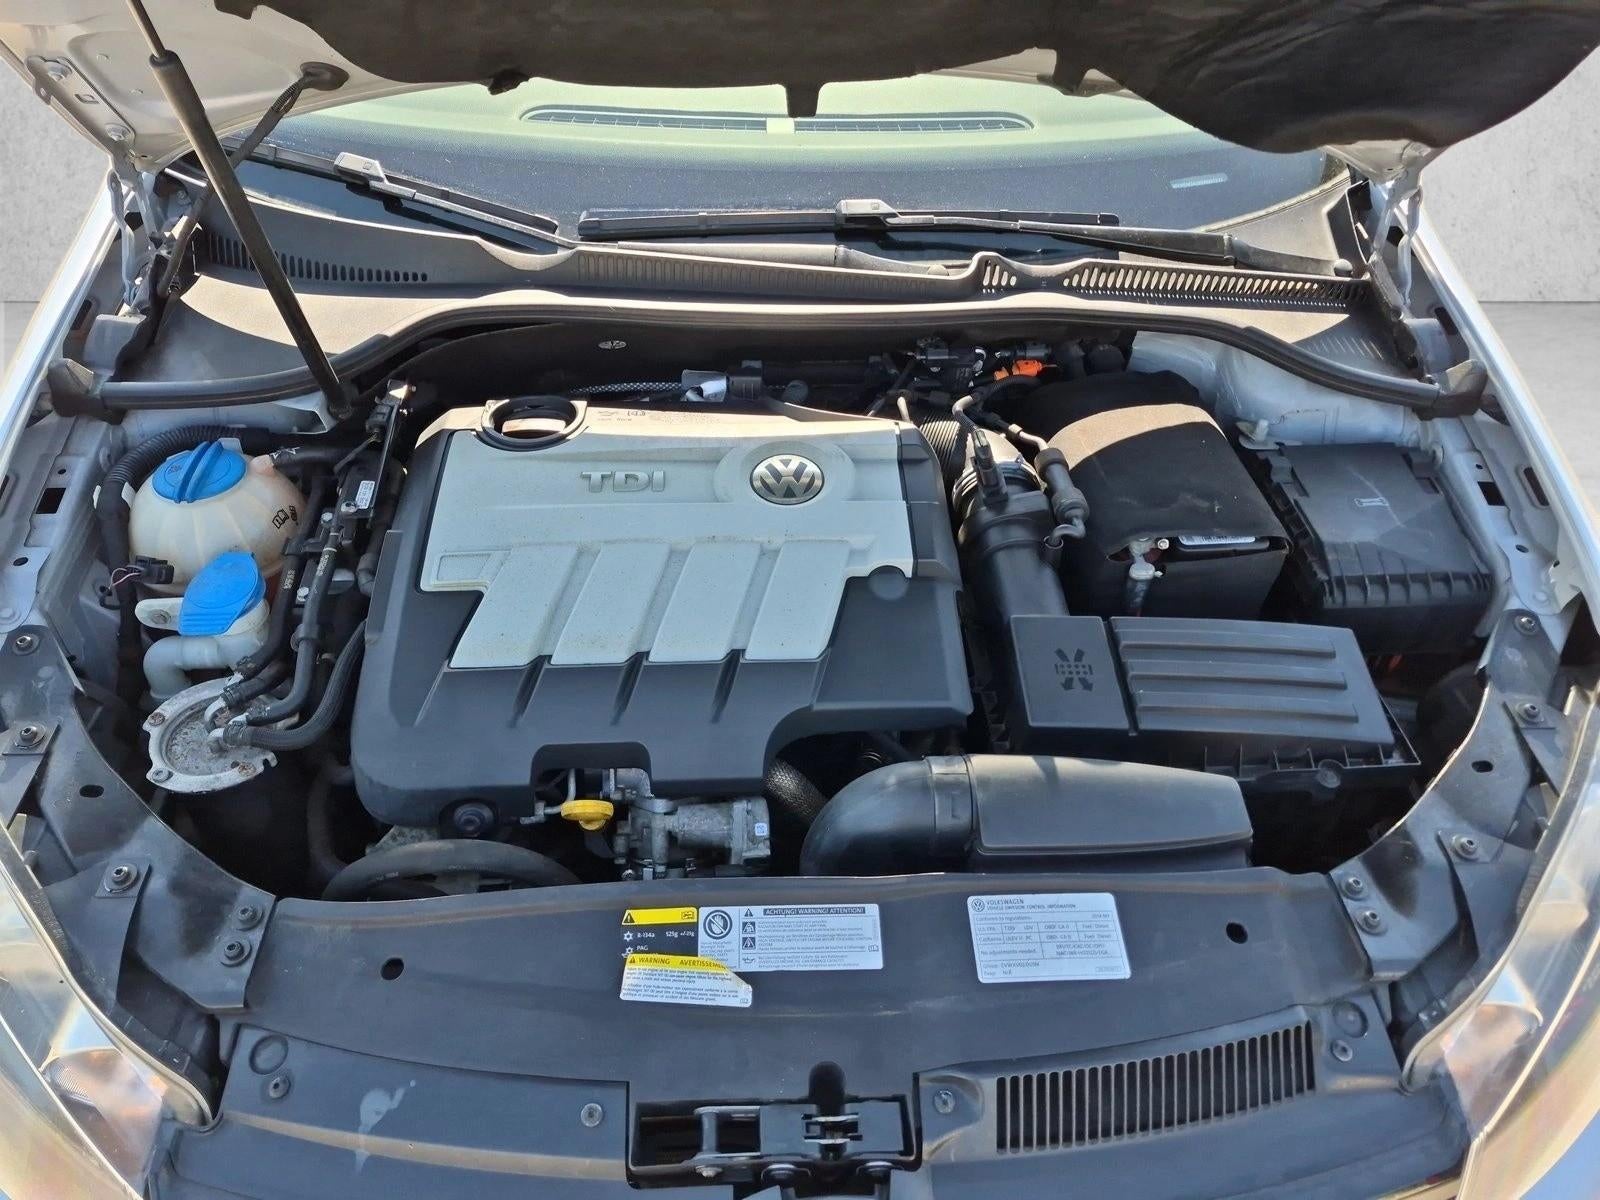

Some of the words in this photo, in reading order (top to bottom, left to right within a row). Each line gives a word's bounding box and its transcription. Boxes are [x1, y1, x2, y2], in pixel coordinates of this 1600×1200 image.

[580, 471, 665, 493] TDI
[986, 898, 1024, 906] VOLKSWAGEN
[639, 956, 670, 964] WARNING
